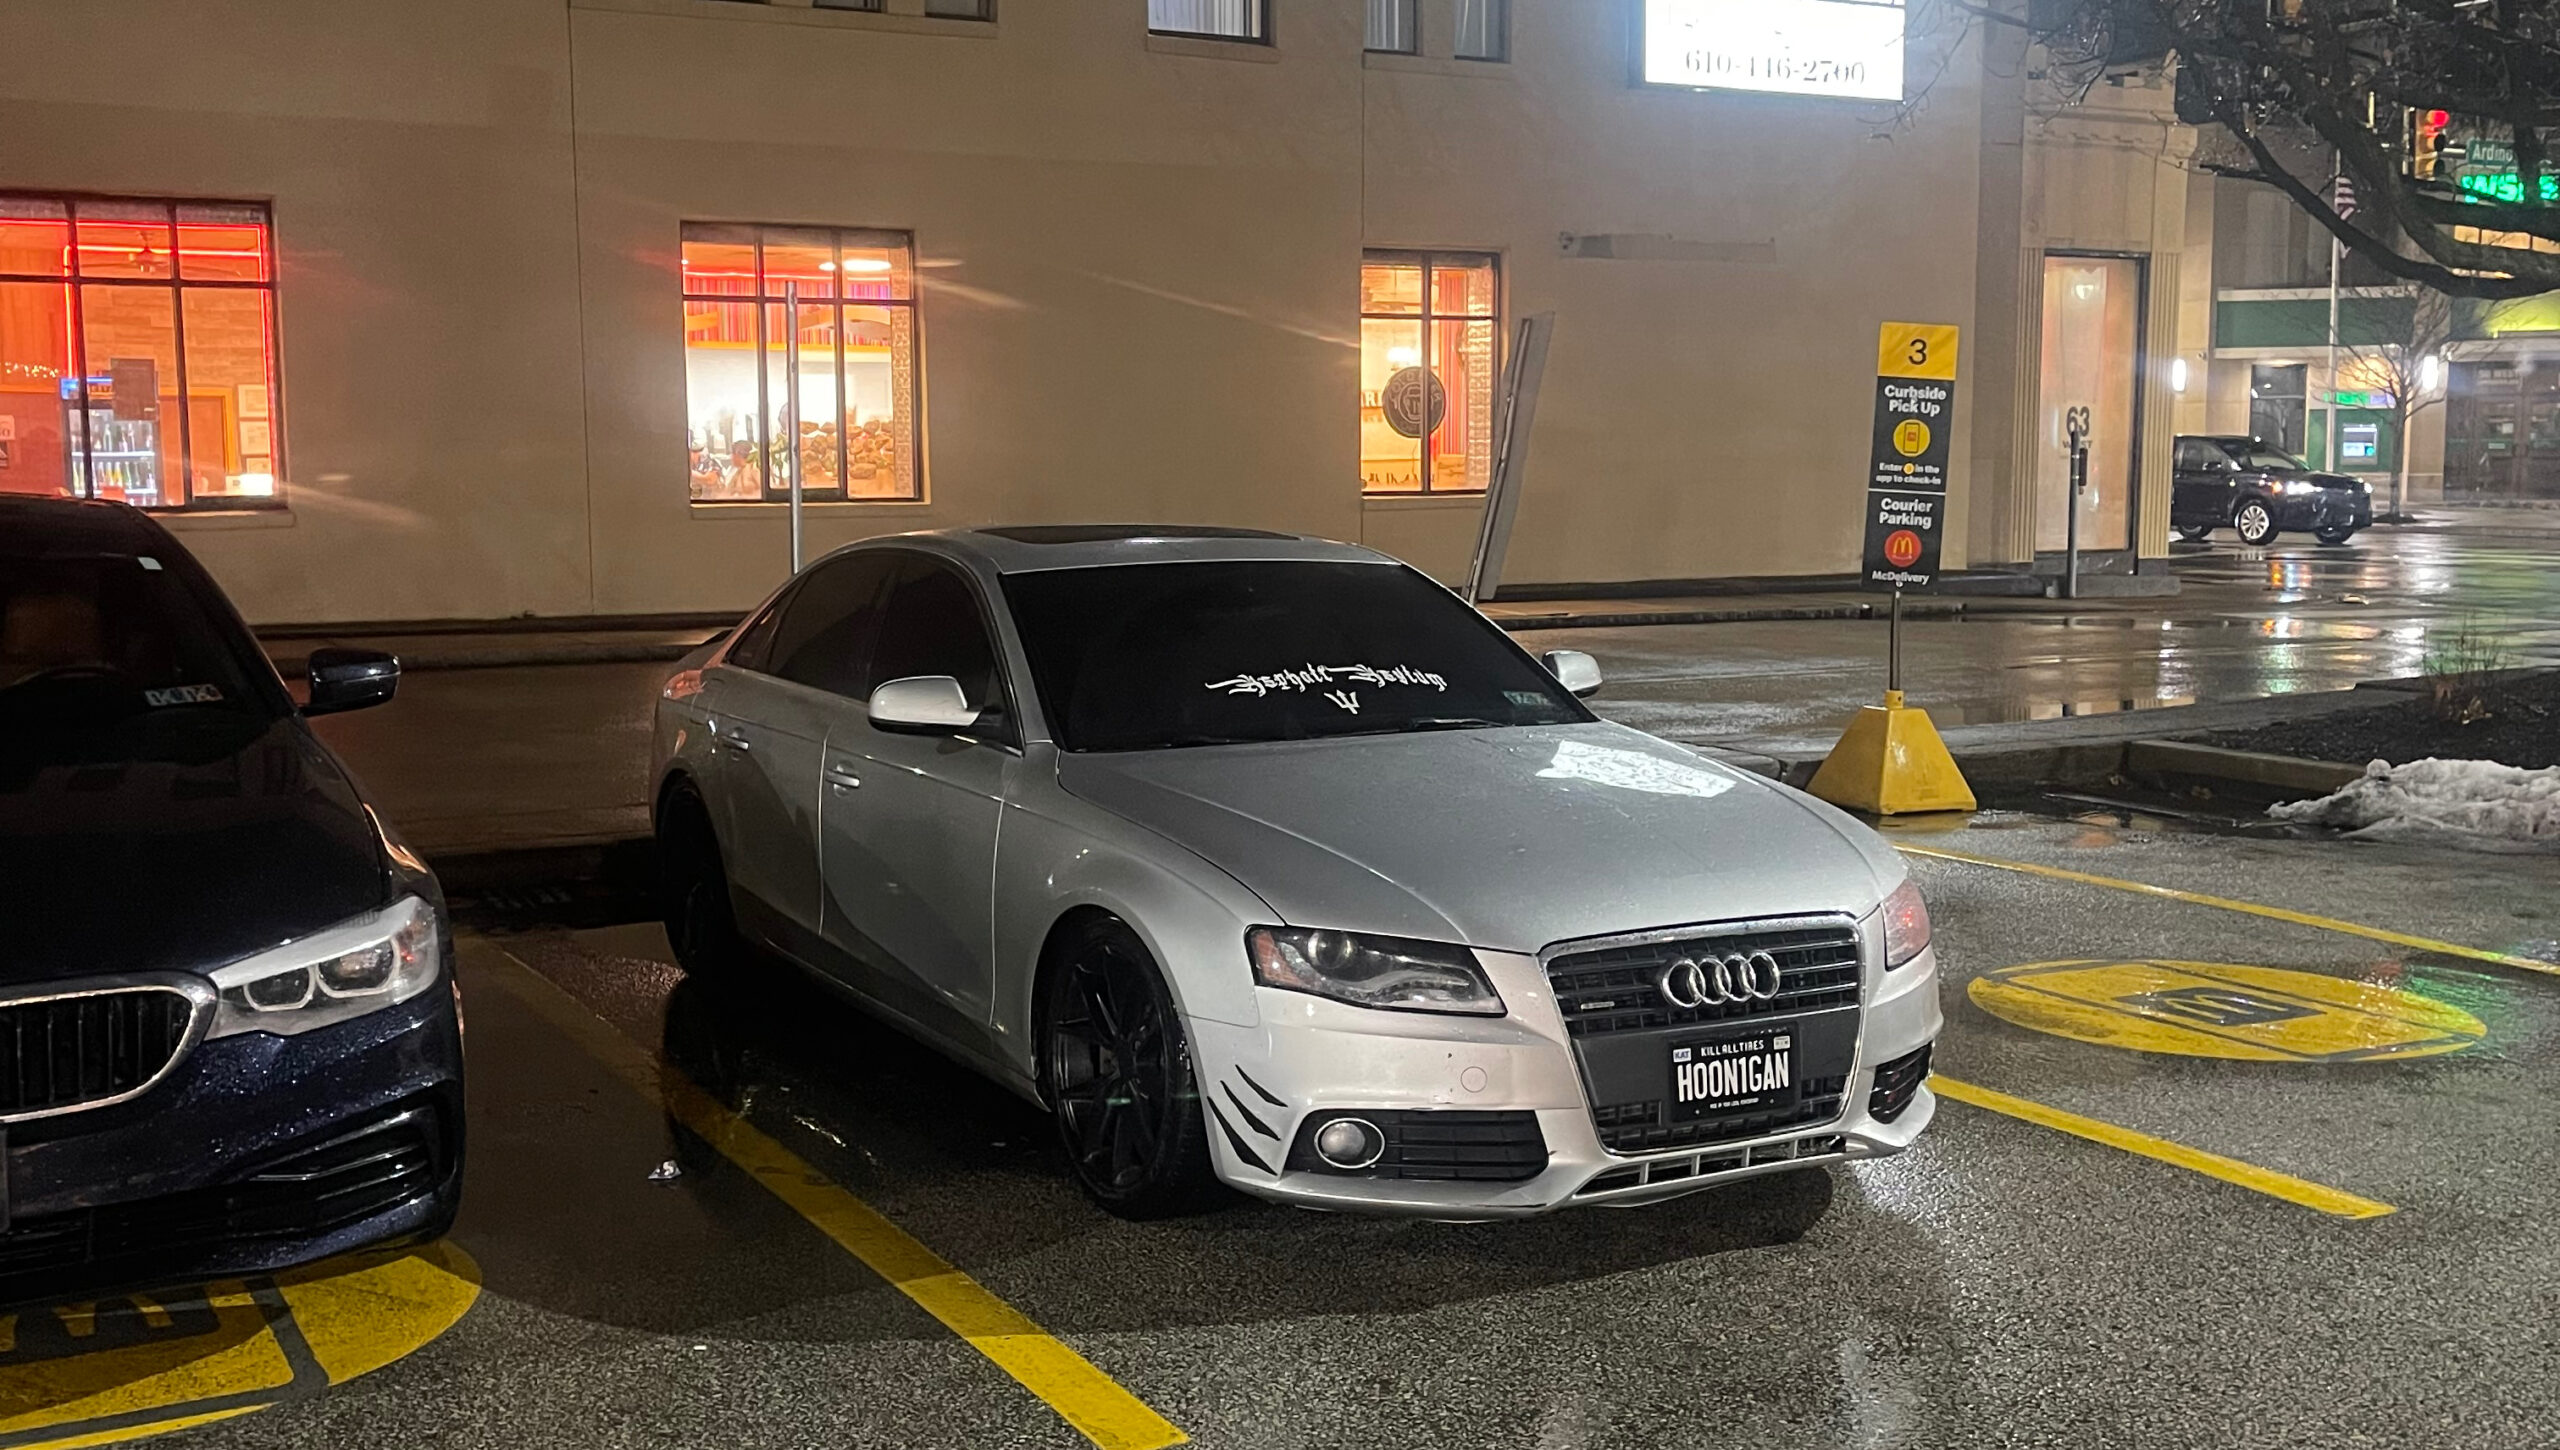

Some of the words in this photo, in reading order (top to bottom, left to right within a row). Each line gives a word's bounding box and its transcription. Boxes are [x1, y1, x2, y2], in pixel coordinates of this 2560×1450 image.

[2472, 143, 2515, 162] Ardmo
[1908, 338, 1927, 365] 3
[1884, 385, 1947, 400] Curbside
[1889, 400, 1918, 413] Pick
[1920, 402, 1941, 417] Up
[2066, 406, 2090, 437] 63
[1879, 462, 1903, 472] Enter
[1893, 475, 1903, 483] to
[1881, 498, 1933, 513] Courier
[1879, 511, 1932, 530] Parking
[1872, 570, 1930, 586] McDelivery
[1677, 1050, 1789, 1103] HOON1GAN
